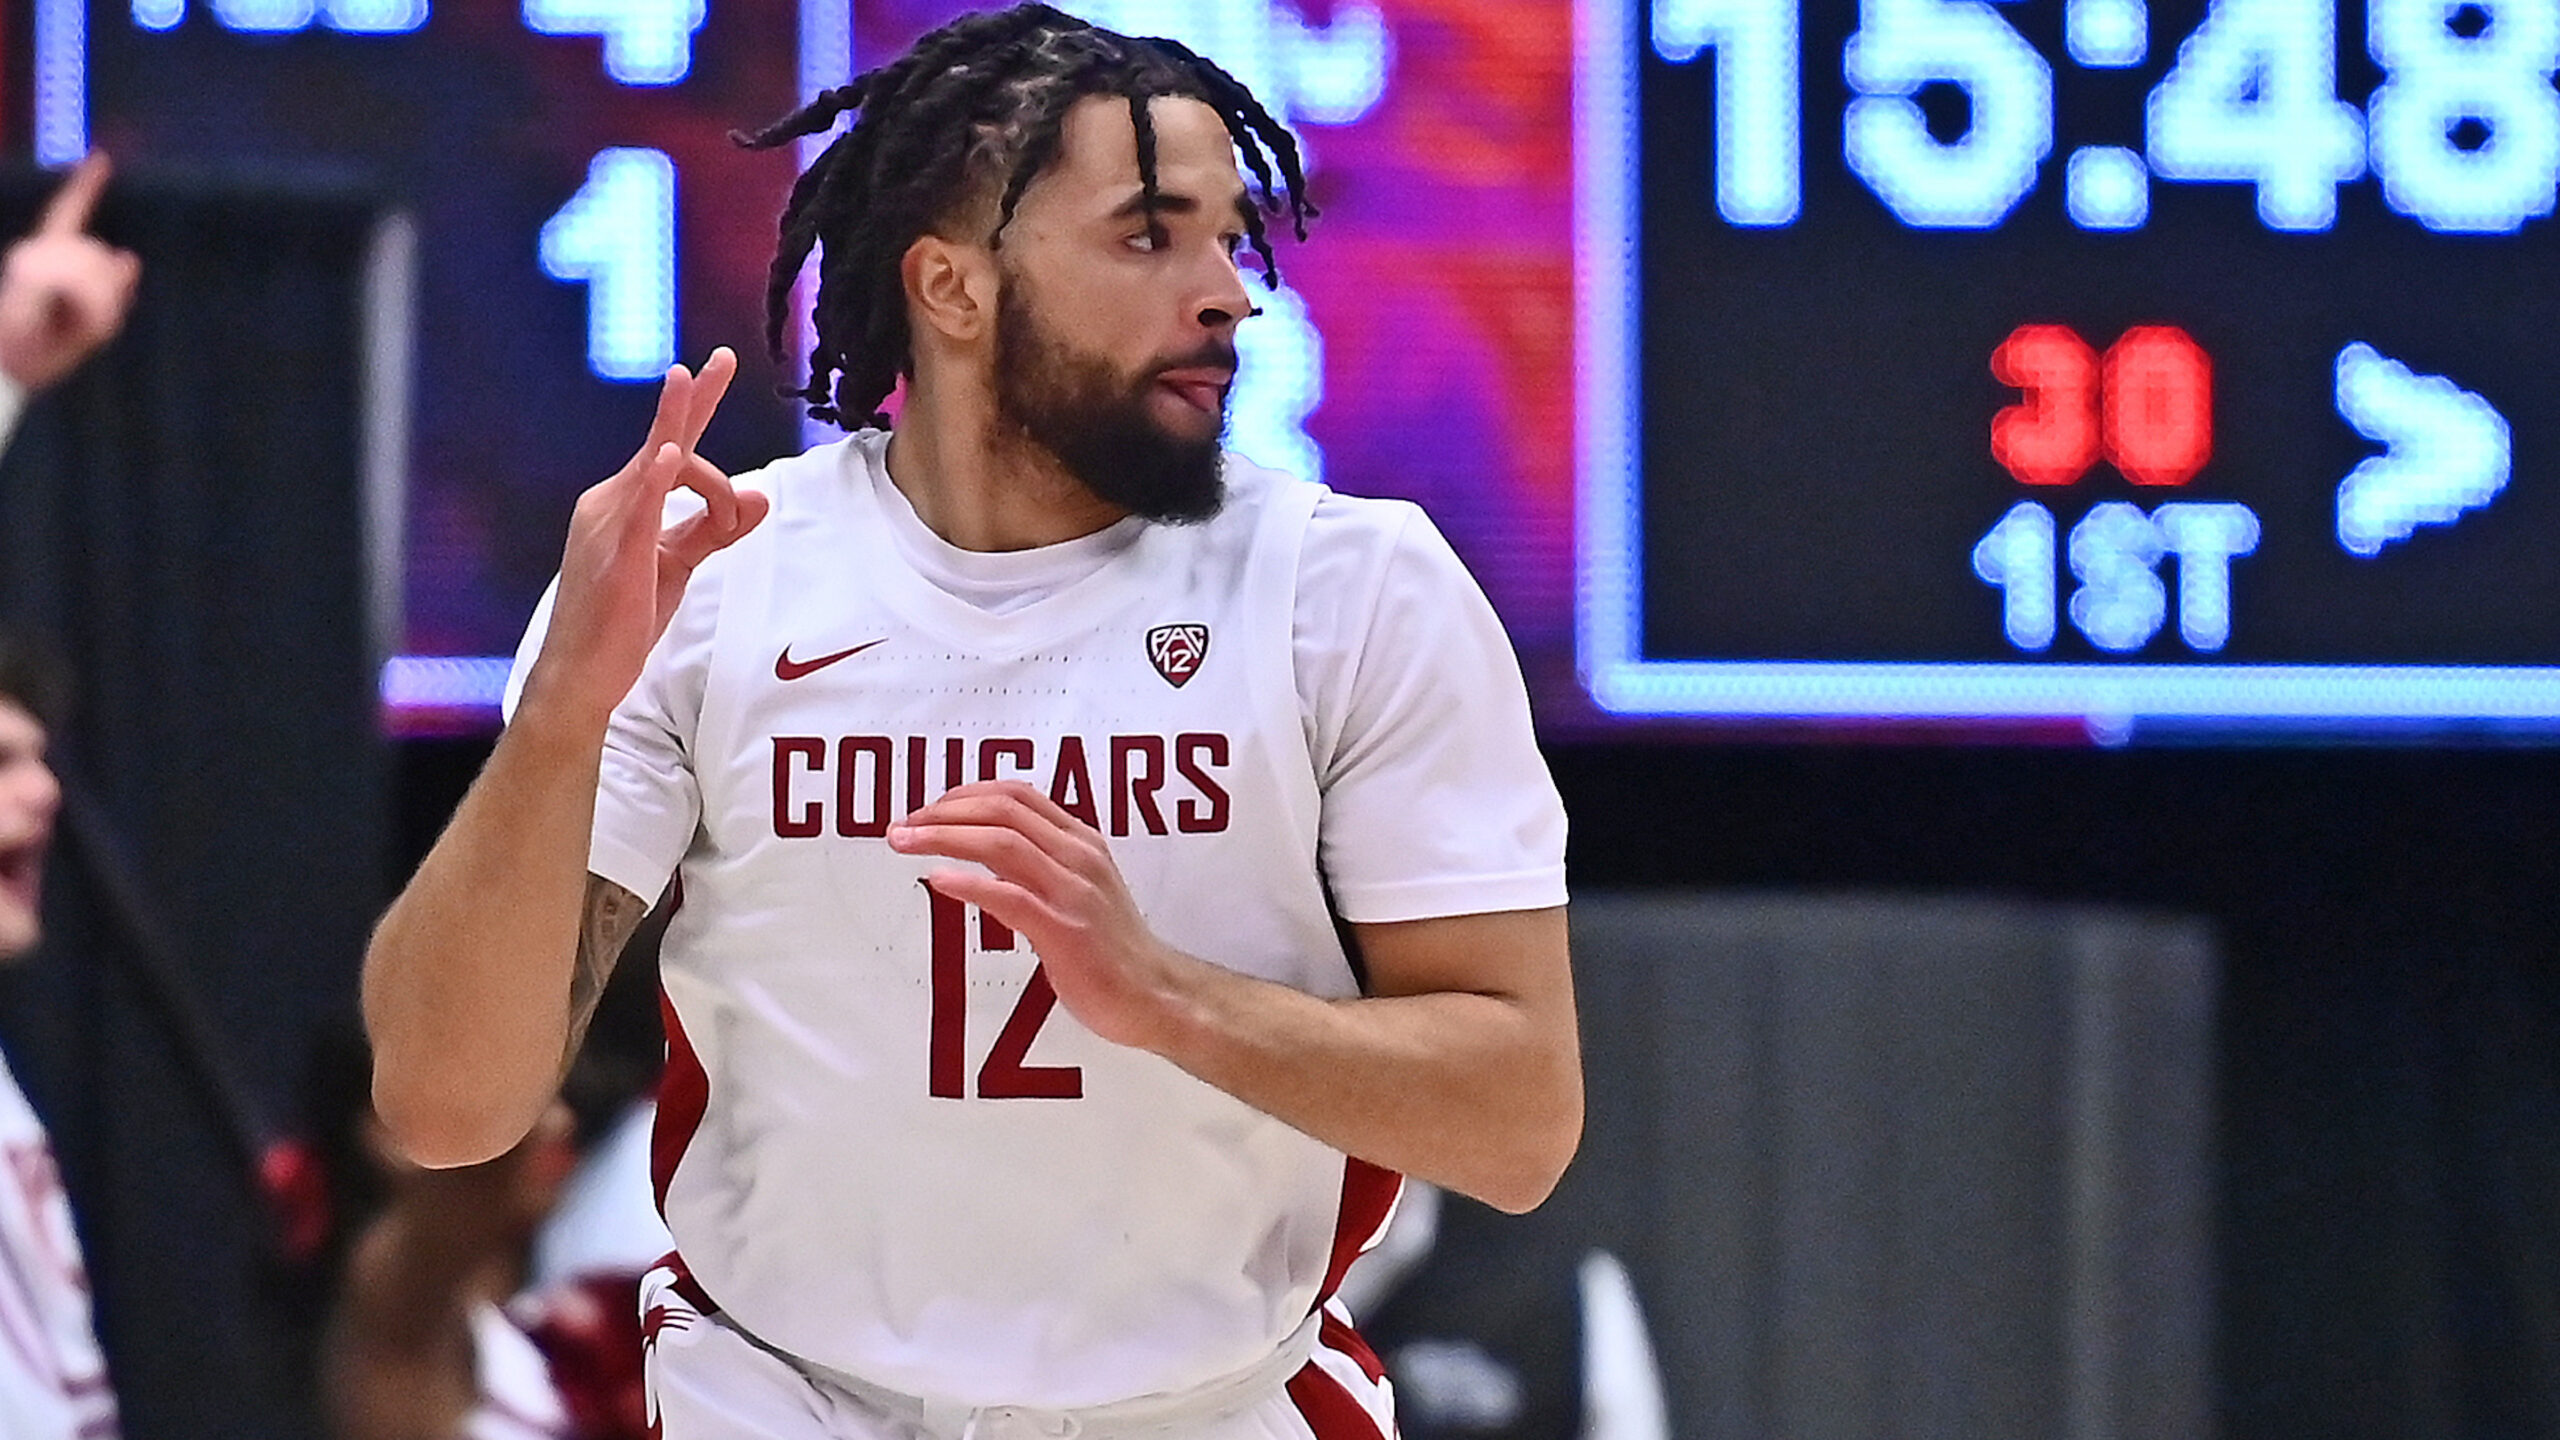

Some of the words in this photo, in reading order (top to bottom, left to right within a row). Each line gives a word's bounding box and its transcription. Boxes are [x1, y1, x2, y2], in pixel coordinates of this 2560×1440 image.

[1652, 0, 2560, 233] 15:48
[538, 145, 679, 380] 1
[1990, 324, 2213, 486] 30
[1151, 626, 1205, 662] PAC
[1971, 500, 2262, 651] 1ST
[1164, 648, 1192, 673] 12
[916, 876, 1083, 1099] 12
